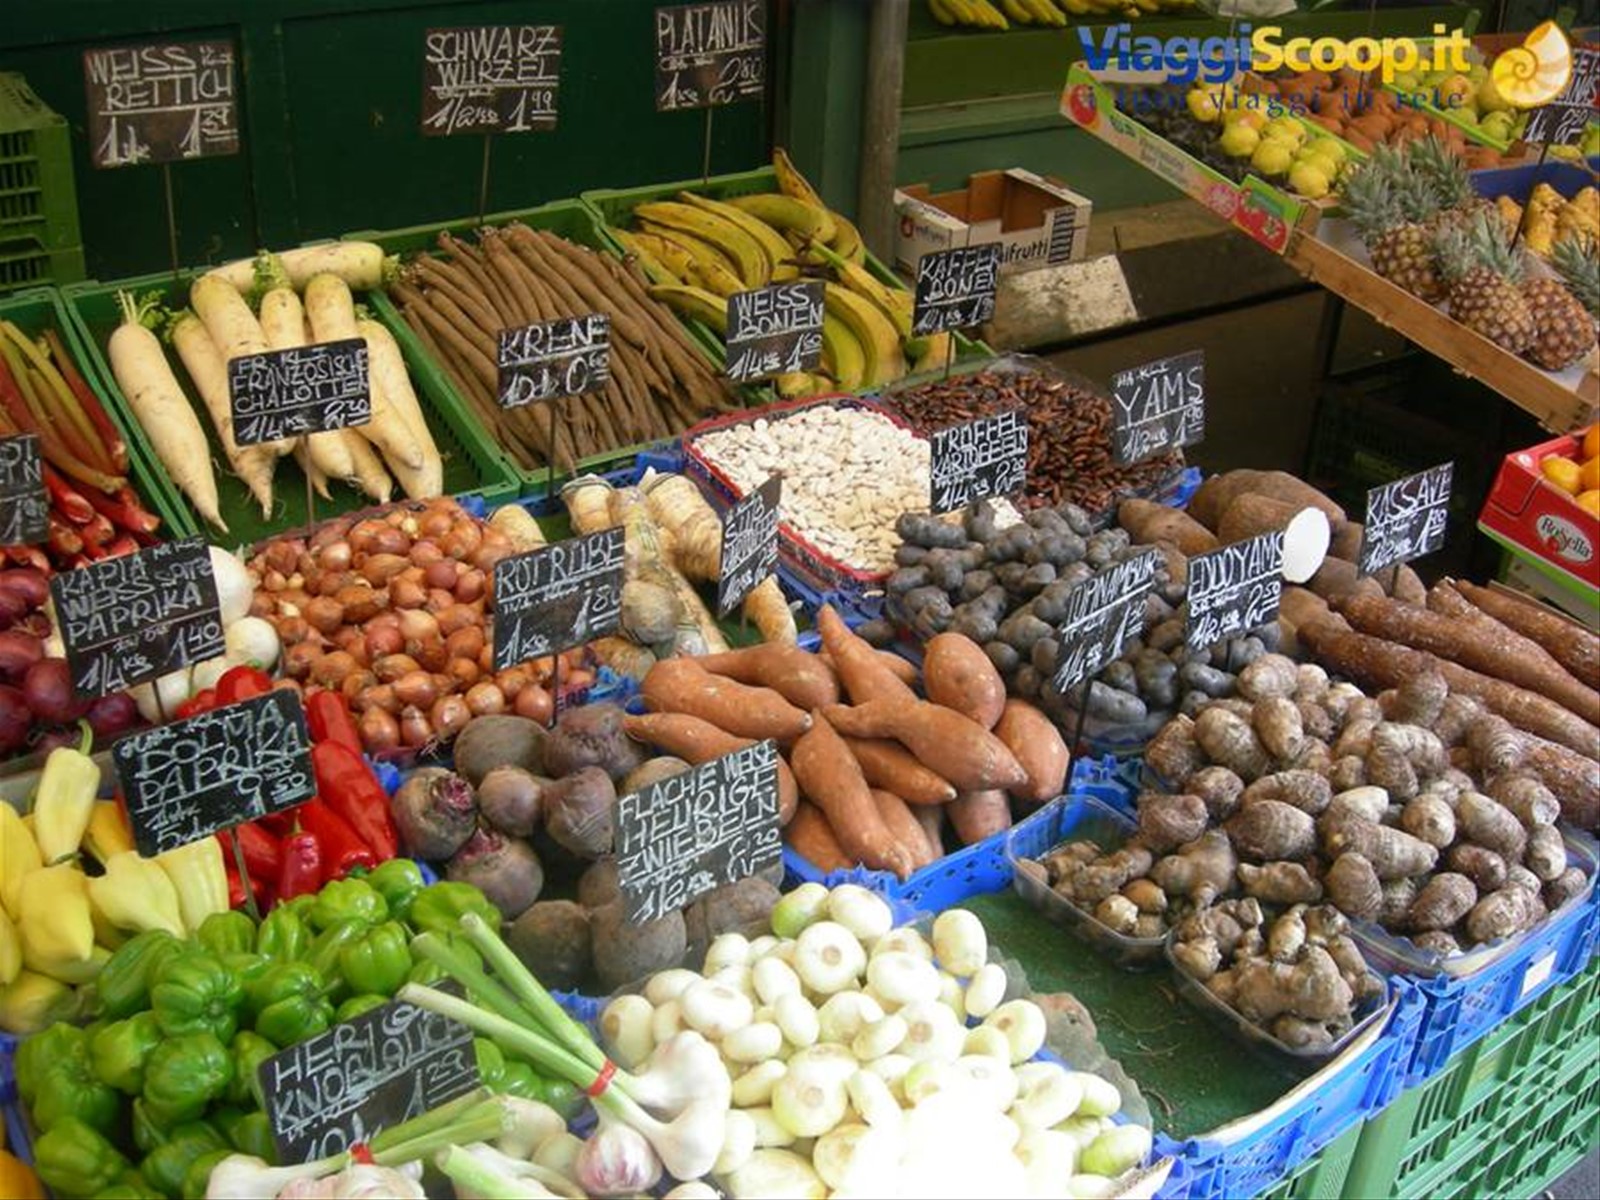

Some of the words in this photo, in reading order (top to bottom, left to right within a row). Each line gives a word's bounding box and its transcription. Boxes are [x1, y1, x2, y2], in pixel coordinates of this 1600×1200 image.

[85, 46, 197, 84] WEISS
[426, 27, 561, 61] SCHWARZ
[735, 284, 810, 317] WEISS
[1114, 365, 1203, 427] YAMS
[66, 581, 203, 647] PAPRIKA
[619, 762, 718, 826] FLACHE
[623, 765, 776, 854] HEURIGE
[618, 791, 778, 886] ZWIEBELN
